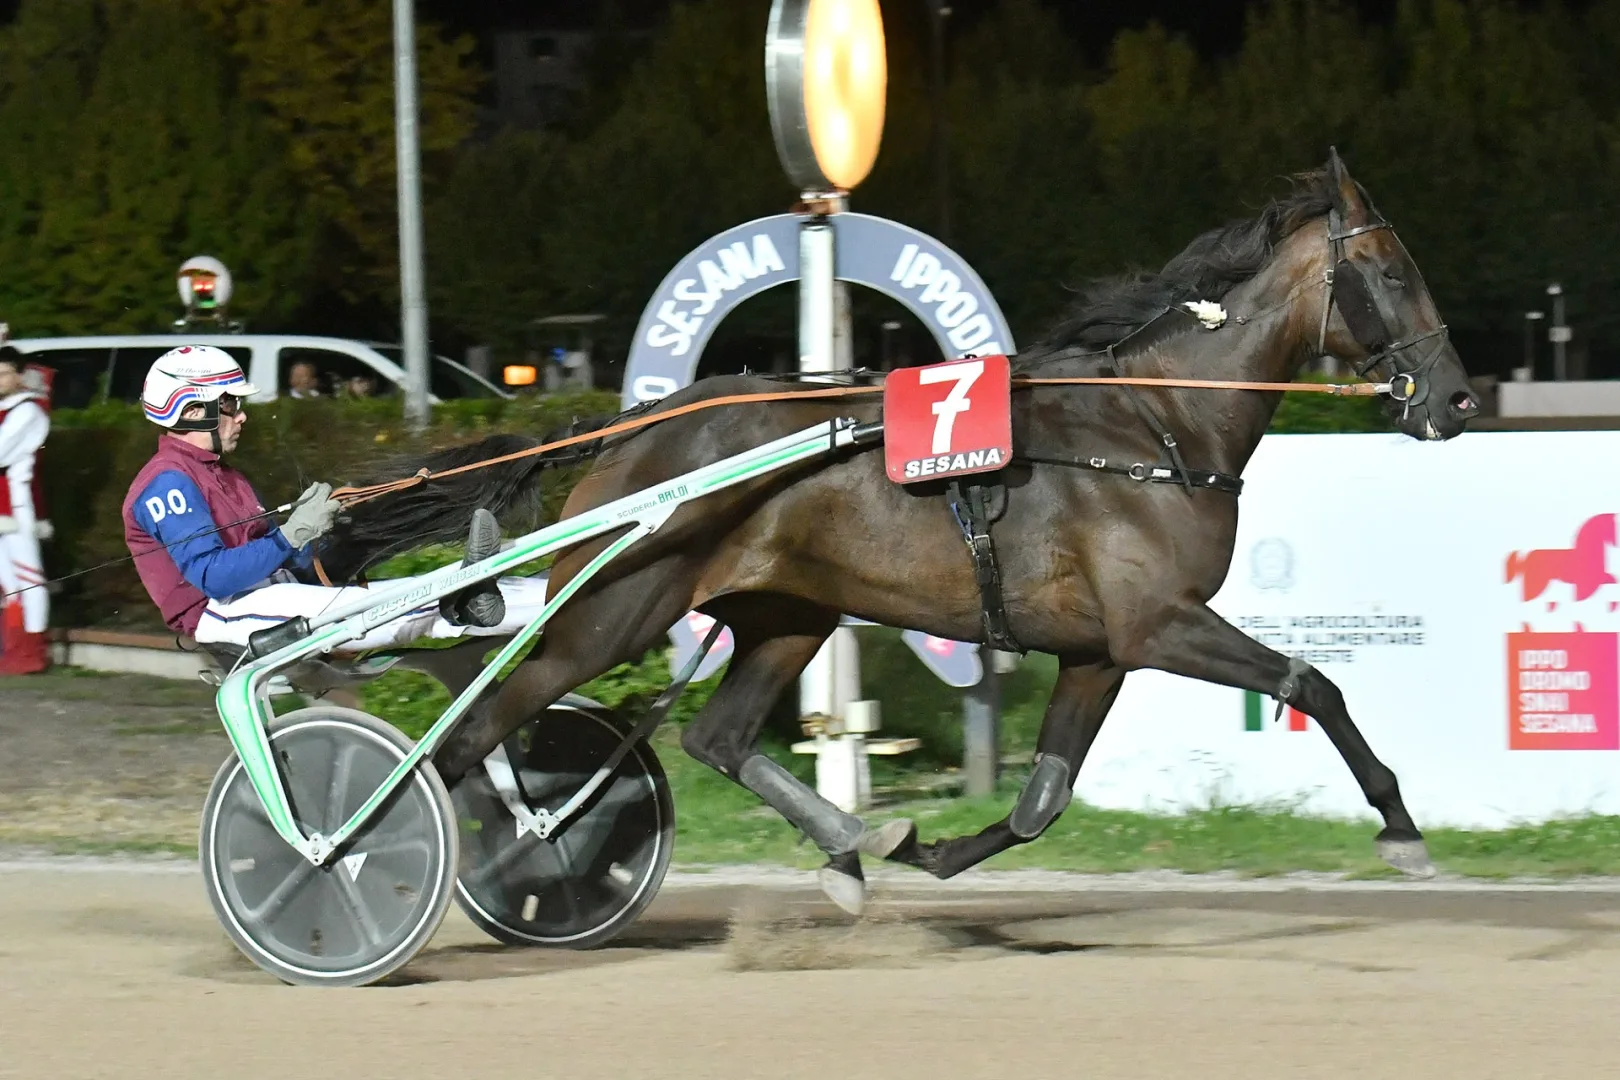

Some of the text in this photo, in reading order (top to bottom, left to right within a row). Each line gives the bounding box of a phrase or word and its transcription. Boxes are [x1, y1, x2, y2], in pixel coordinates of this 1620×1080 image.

[646, 234, 786, 356] SESANA
[919, 360, 985, 455] 7
[904, 448, 1001, 479] SESANA
[145, 488, 194, 524] D.O.
[617, 484, 689, 519] SCUDERIA BALDI
[367, 582, 433, 621] CUSTOM
